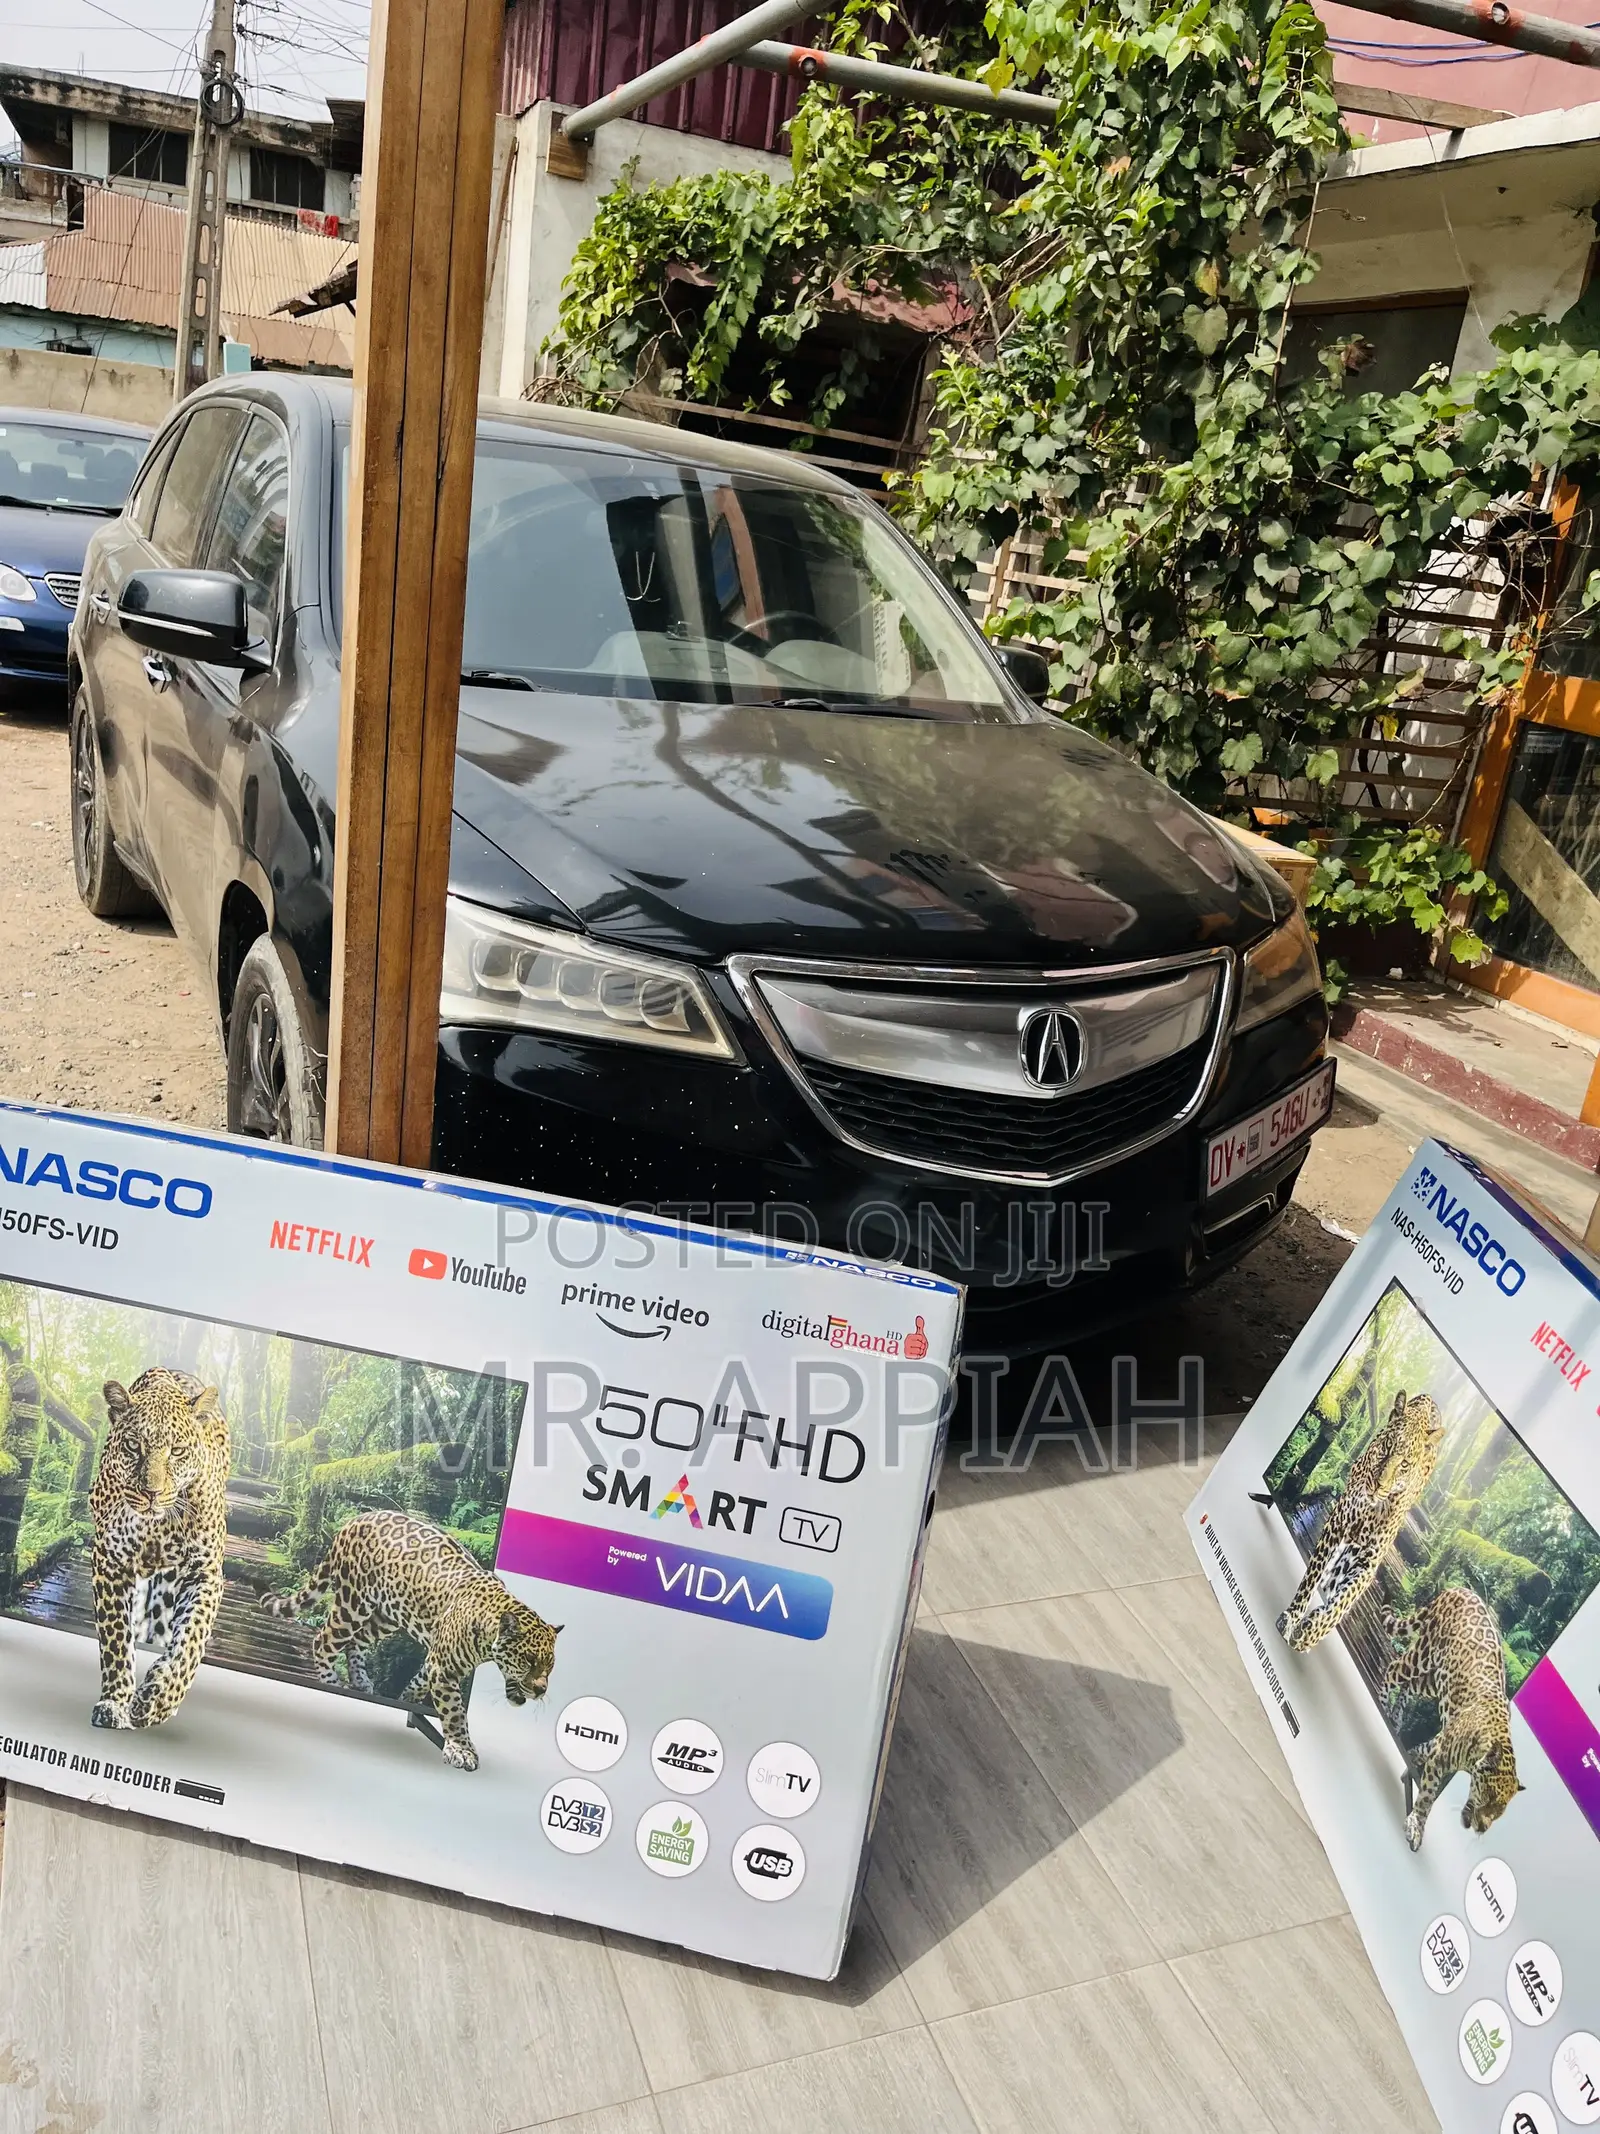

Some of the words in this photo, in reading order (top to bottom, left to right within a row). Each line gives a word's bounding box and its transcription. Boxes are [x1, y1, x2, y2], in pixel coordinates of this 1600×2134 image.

[0, 1144, 213, 1219] NASCO
[1211, 1136, 1235, 1187] DV
[0, 1206, 119, 1250] 50FS-VID
[270, 1220, 375, 1268] NETFLIX
[1427, 1184, 1526, 1296] NASCO
[1390, 1206, 1464, 1295] NAS-H50FS-VID
[451, 1257, 527, 1295] YouTube
[808, 1256, 937, 1289] NASCO
[561, 1282, 636, 1312] prime
[642, 1297, 710, 1327] video
[886, 1330, 903, 1341] HD
[1530, 1321, 1591, 1392] NETFLIX
[582, 1463, 767, 1535] SMART
[793, 1516, 830, 1544] TV
[607, 1555, 619, 1566] by
[608, 1545, 647, 1562] Powered
[1204, 1523, 1222, 1560] BUILT-IN
[1218, 1555, 1237, 1593] VOLTAGE
[1233, 1587, 1258, 1641] REGULATOR
[1253, 1634, 1266, 1660] AND
[1261, 1655, 1285, 1704] DECODER
[564, 1722, 619, 1746] HDMI
[69, 1754, 101, 1776] AND
[103, 1762, 171, 1794] DECODER
[667, 1758, 705, 1773] AUDIO
[649, 1843, 690, 1863] SAVING
[651, 1832, 692, 1850] ENERGY
[749, 1852, 793, 1877] USB
[1477, 1872, 1506, 1923] HDMI
[1519, 1972, 1540, 2008] AUDIO
[1465, 2030, 1489, 2073] SAVING
[1471, 2021, 1496, 2062] ENERGY
